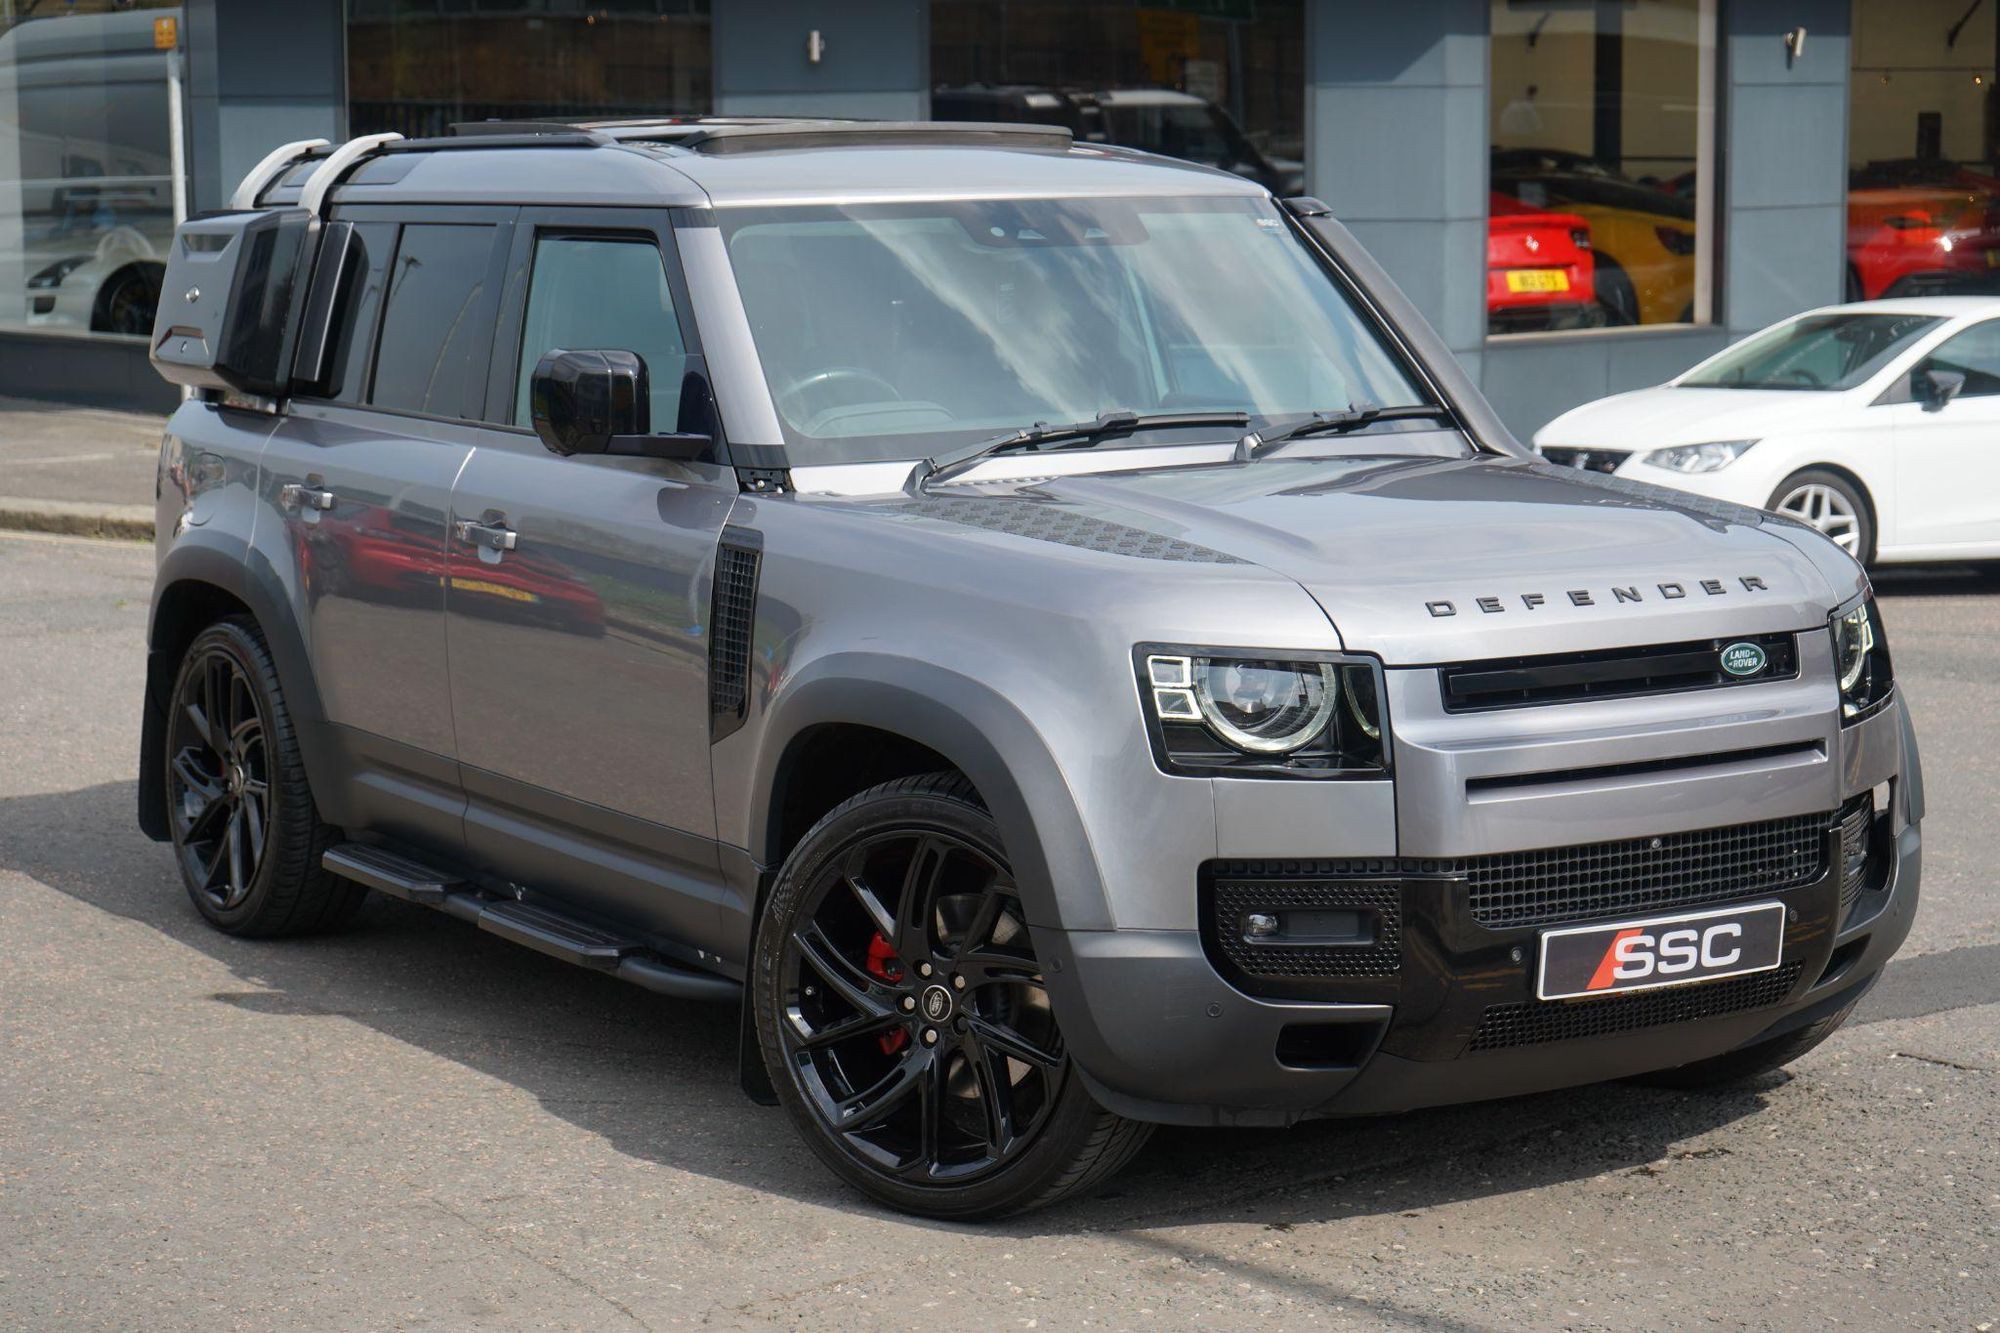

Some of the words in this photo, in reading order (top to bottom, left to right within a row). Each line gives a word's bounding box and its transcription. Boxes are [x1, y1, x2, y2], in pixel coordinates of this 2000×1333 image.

[1425, 576, 1768, 617] DEFENDER
[1730, 649, 1751, 660] LAND
[1733, 657, 1758, 668] ROVER
[1612, 922, 1742, 980] SSC
